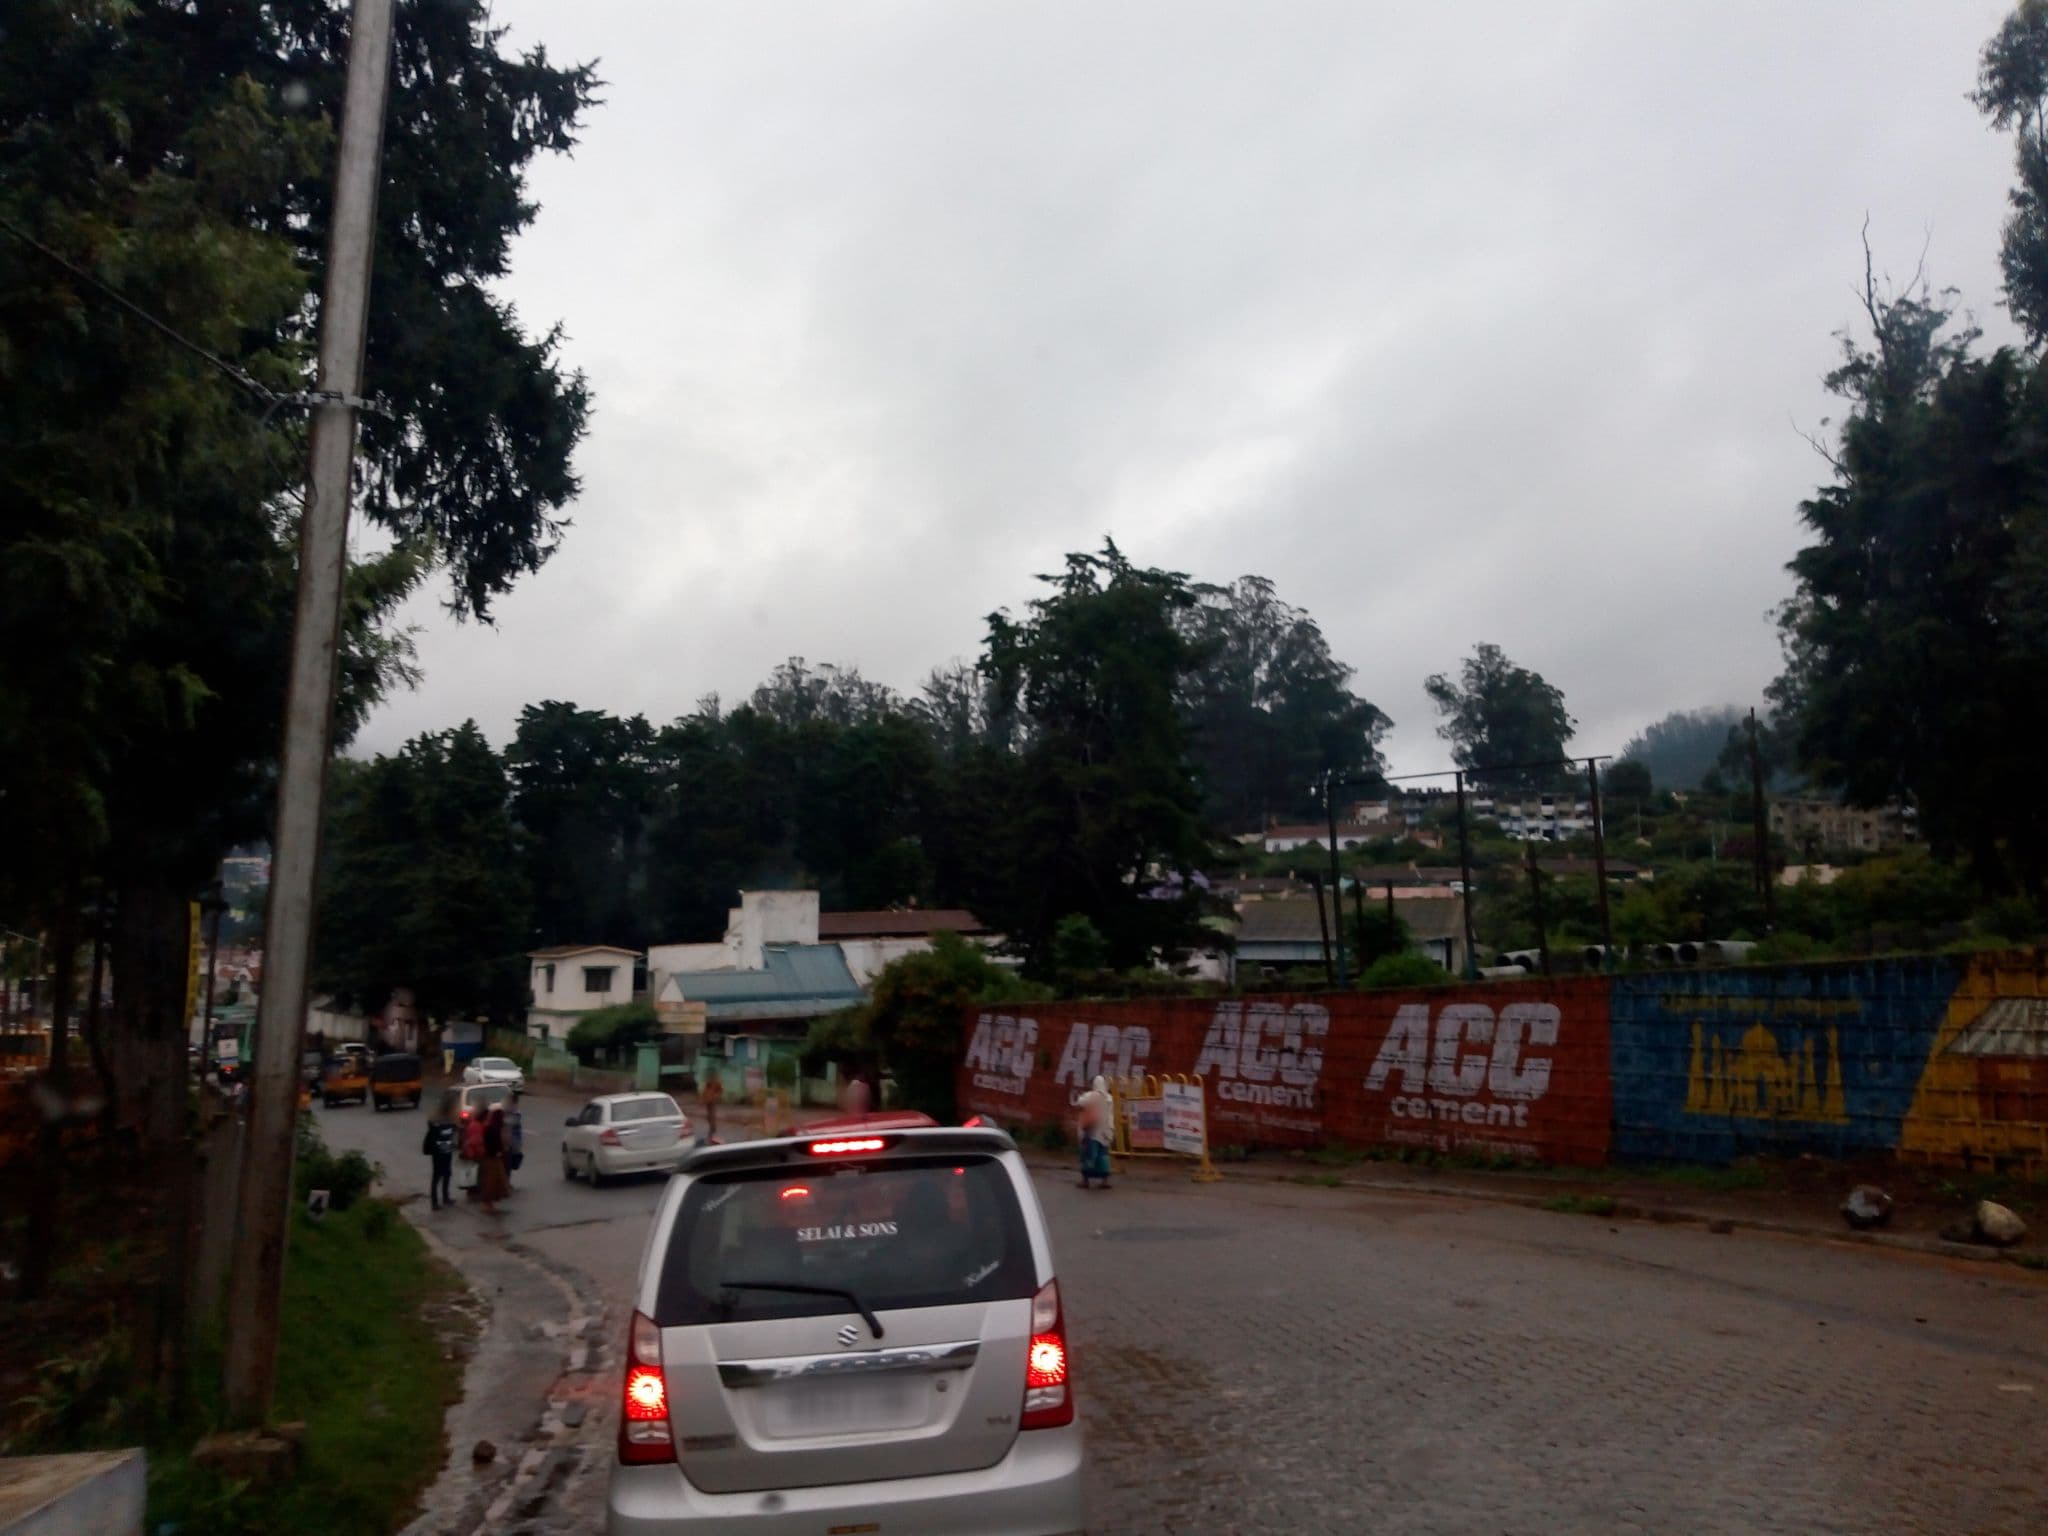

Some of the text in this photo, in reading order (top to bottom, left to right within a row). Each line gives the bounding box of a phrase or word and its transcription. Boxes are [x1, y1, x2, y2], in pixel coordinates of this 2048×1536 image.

[966, 1014, 1039, 1078] ACC
[1055, 1022, 1151, 1092] ACC
[1194, 1001, 1330, 1085] ACC
[1363, 1002, 1562, 1101] ACC
[1217, 1081, 1315, 1109] cement
[1391, 1095, 1528, 1127] cement
[843, 1225, 856, 1239] &
[858, 1221, 899, 1237] SONS
